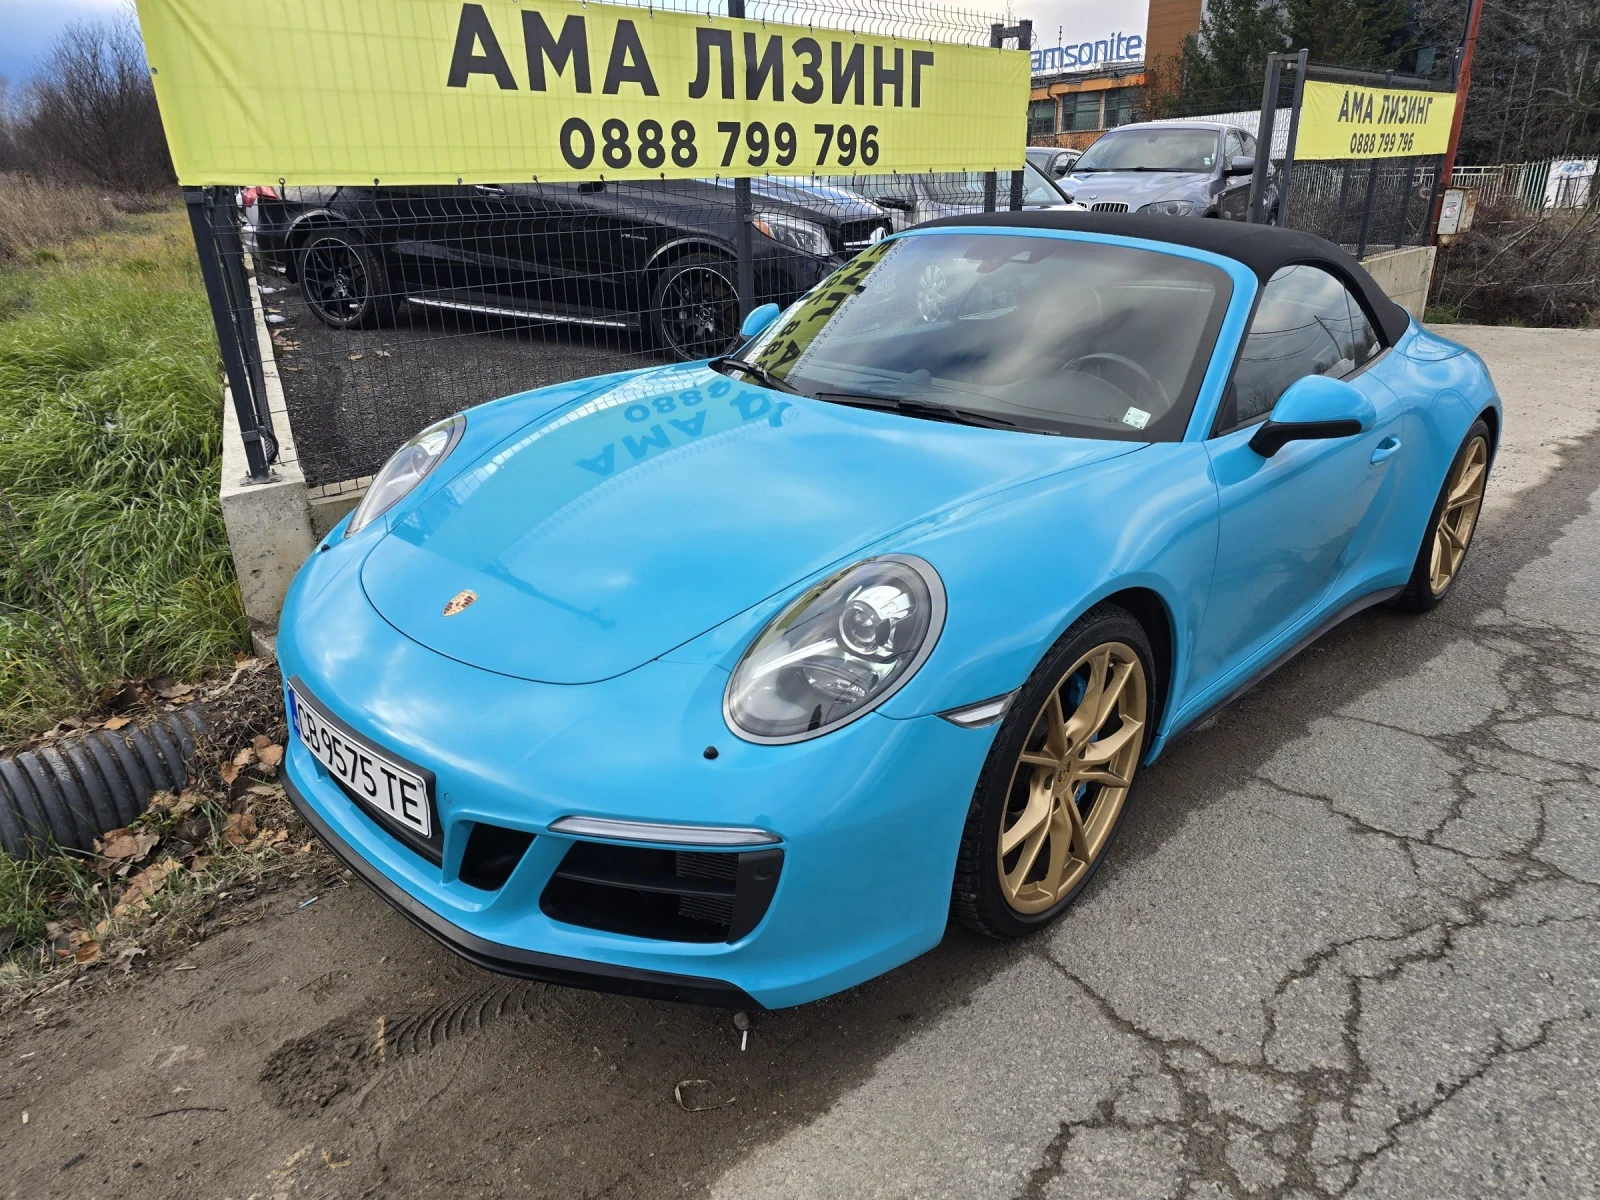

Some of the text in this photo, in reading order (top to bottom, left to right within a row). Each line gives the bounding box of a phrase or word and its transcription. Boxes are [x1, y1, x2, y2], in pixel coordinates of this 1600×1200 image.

[447, 2, 934, 108] АМА ЛИЗИНГ
[1030, 31, 1142, 72] amsonite
[1338, 90, 1434, 124] АМА ЛИЗИНГ
[560, 117, 880, 169] 0888 799 796
[1350, 132, 1415, 154] 0888 799 796
[321, 727, 377, 797] 9575
[380, 766, 422, 825] TE
